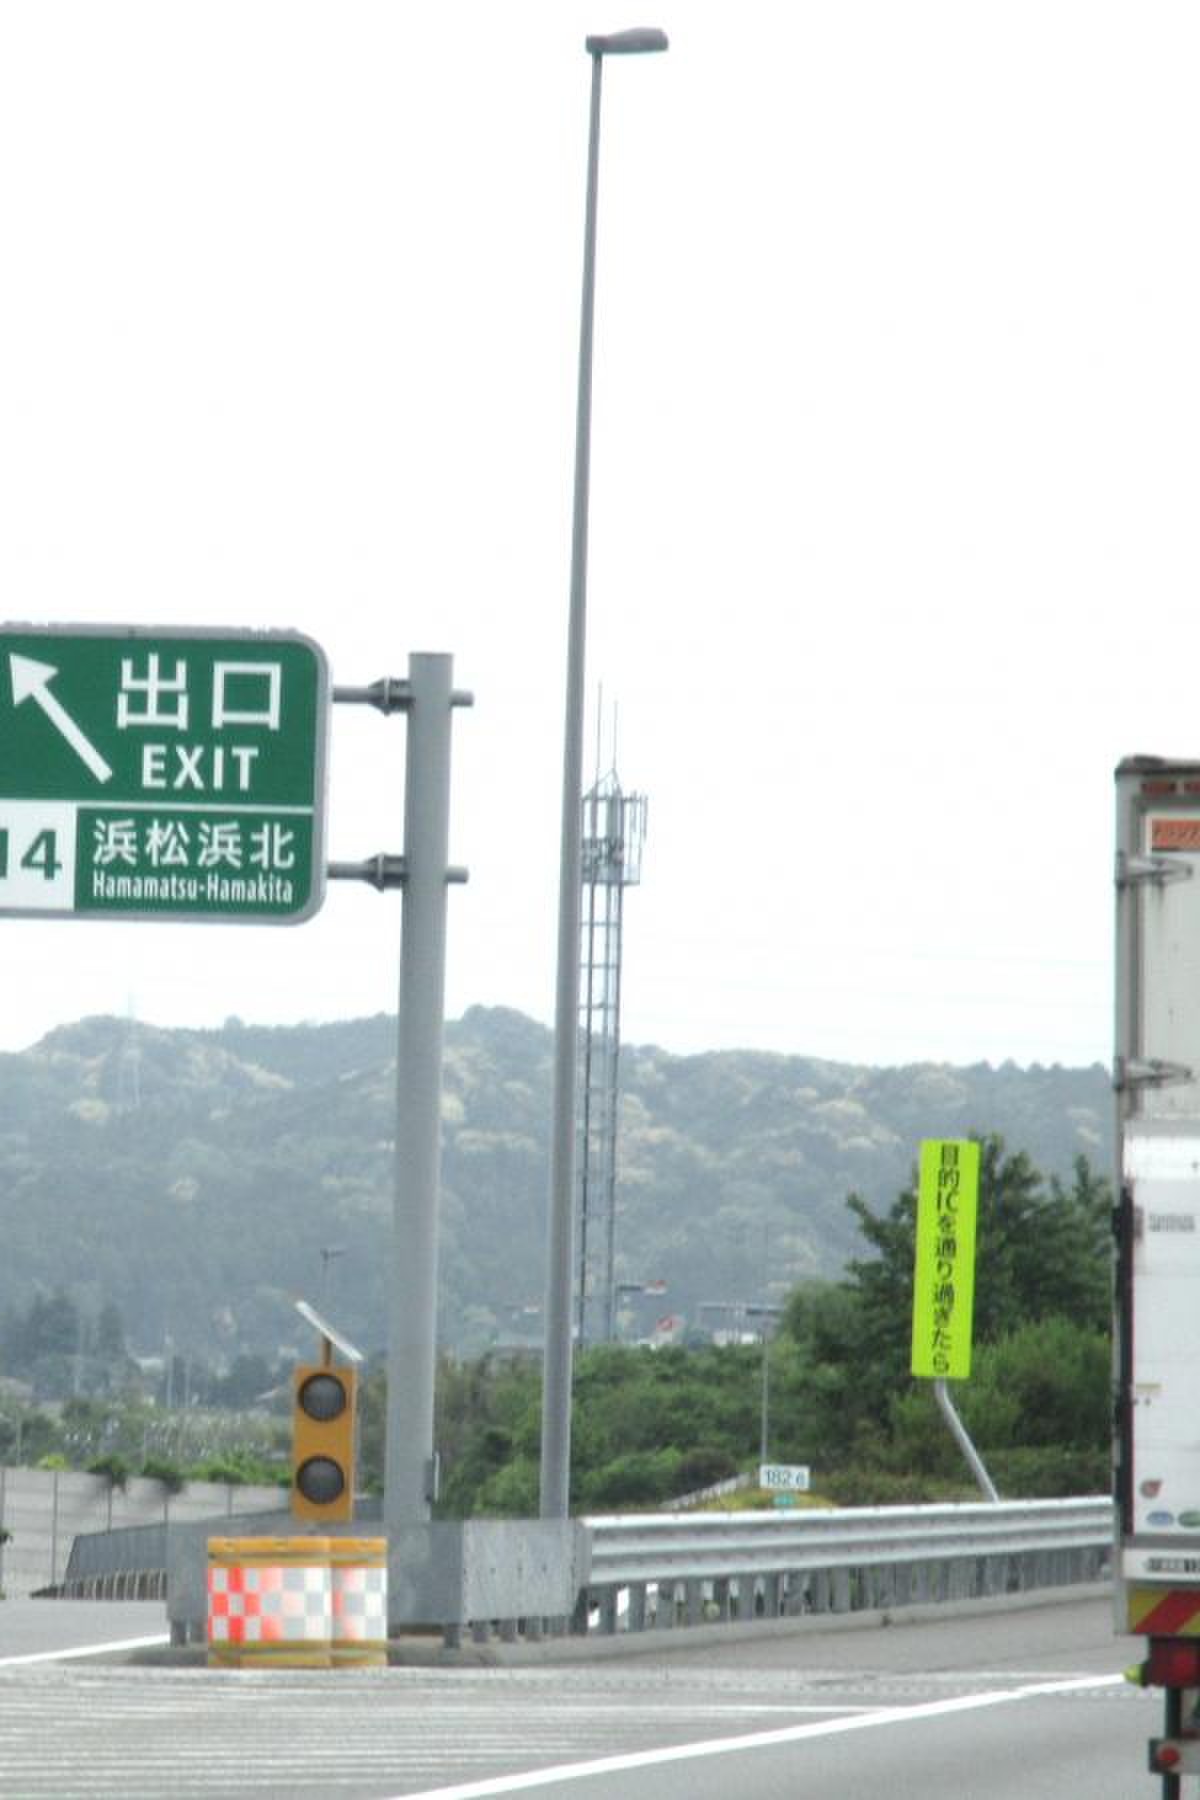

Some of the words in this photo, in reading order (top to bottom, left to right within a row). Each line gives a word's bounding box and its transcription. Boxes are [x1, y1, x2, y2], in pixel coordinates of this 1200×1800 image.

[116, 652, 282, 731] 出口
[140, 744, 260, 791] EXIT
[92, 818, 296, 868] 浜松浜北
